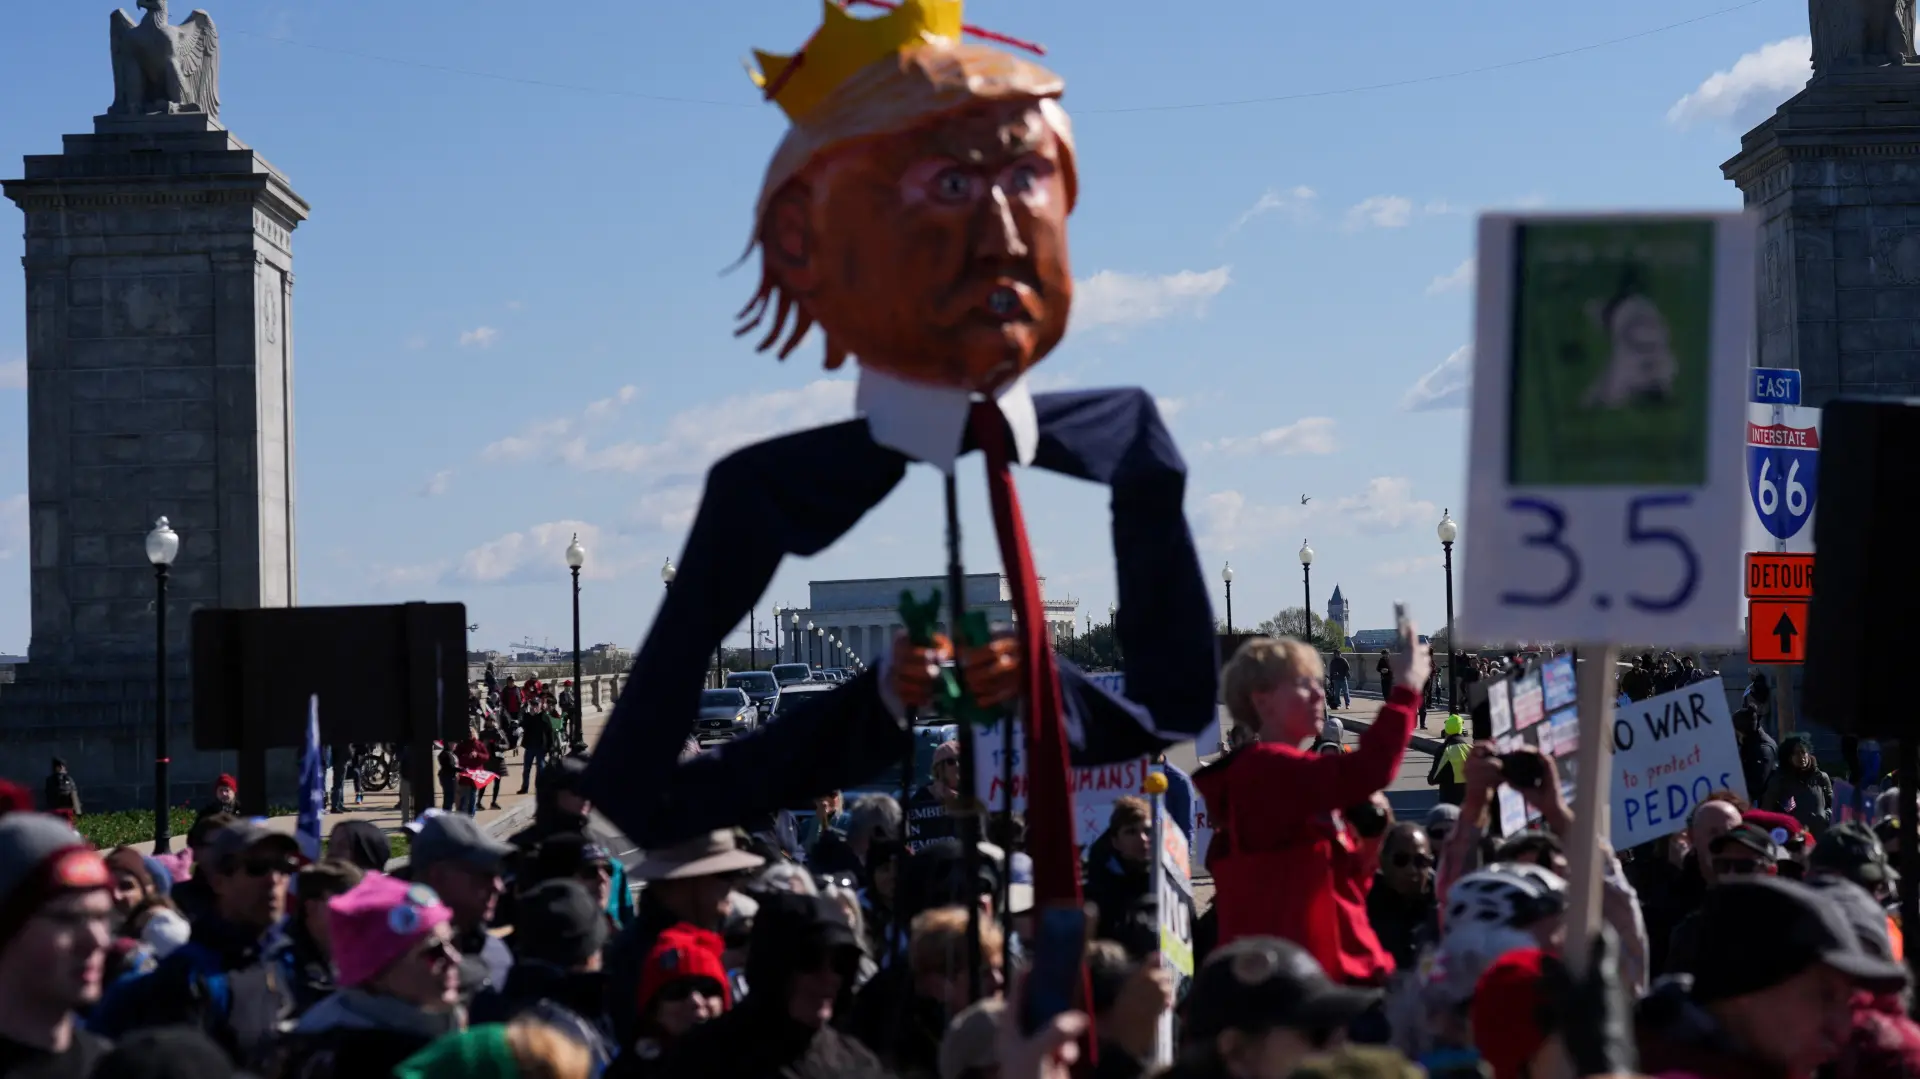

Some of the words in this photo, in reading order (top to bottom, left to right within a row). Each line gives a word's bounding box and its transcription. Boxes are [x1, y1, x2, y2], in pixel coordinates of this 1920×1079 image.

[1756, 375, 1792, 399] EAST
[1752, 427, 1807, 446] INTERSTATE
[1758, 456, 1807, 517] 66
[1500, 494, 1703, 613] 3.5
[1751, 563, 1816, 588] DETOUR
[1643, 693, 1712, 742] WAR
[1622, 768, 1639, 789] to
[1646, 744, 1702, 788] protect
